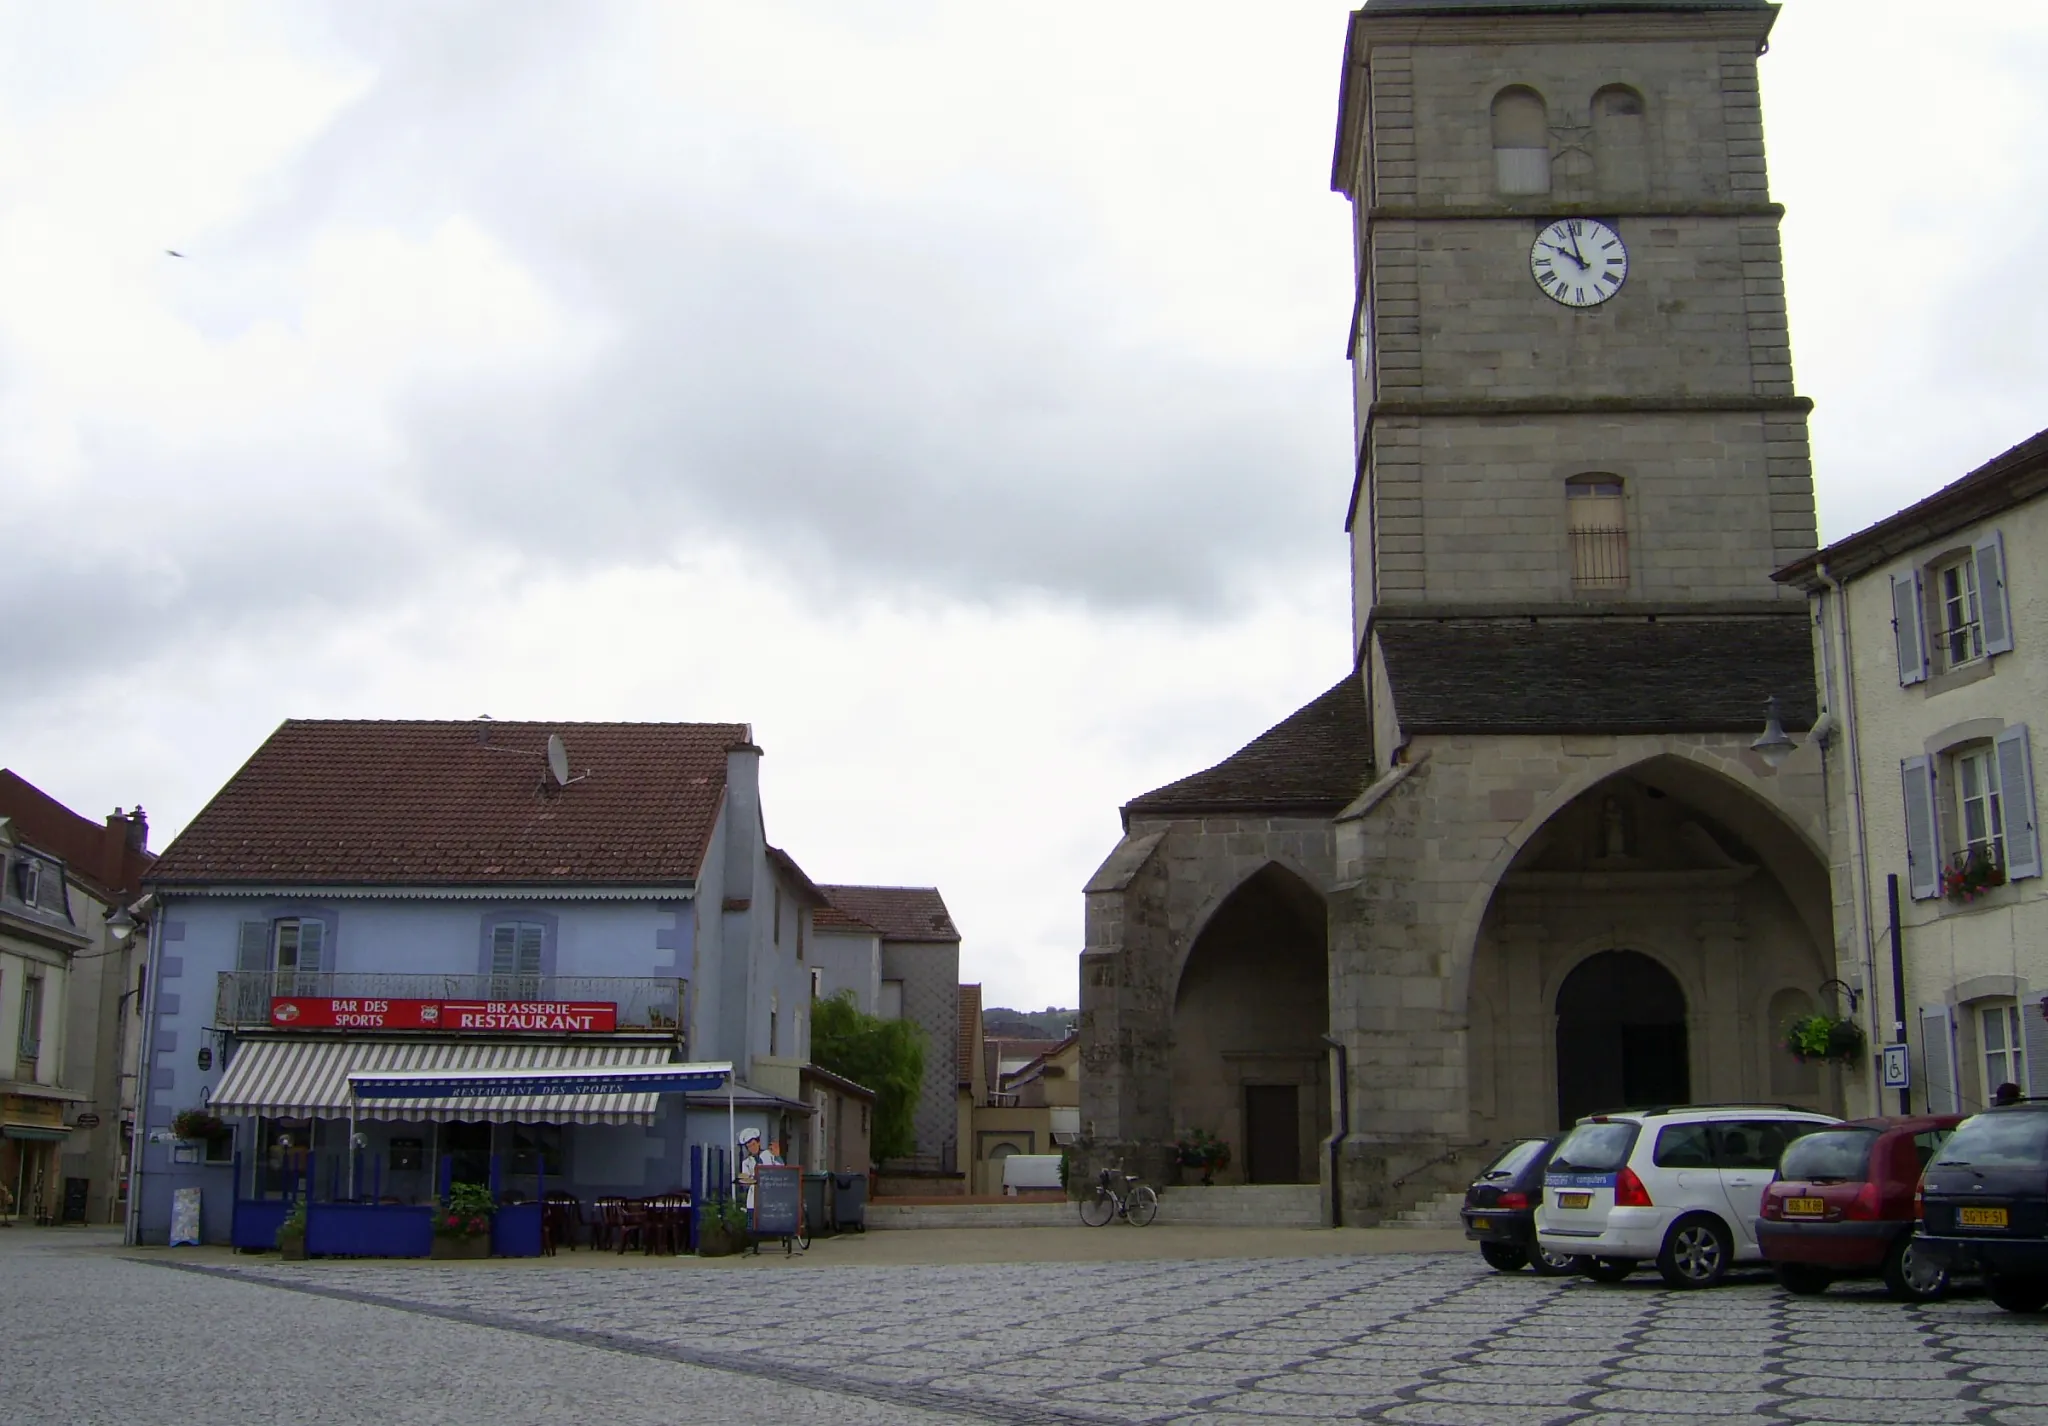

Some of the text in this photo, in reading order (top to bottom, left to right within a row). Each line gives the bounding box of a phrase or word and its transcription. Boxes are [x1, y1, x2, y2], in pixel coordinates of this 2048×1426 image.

[332, 1000, 389, 1013] BAR DES
[486, 1003, 570, 1014] BRASSERIE
[335, 1014, 384, 1026] SPORTS
[460, 1014, 594, 1029] RESTAURANT
[452, 1083, 624, 1097] RESTAURANT DES SPORTS
